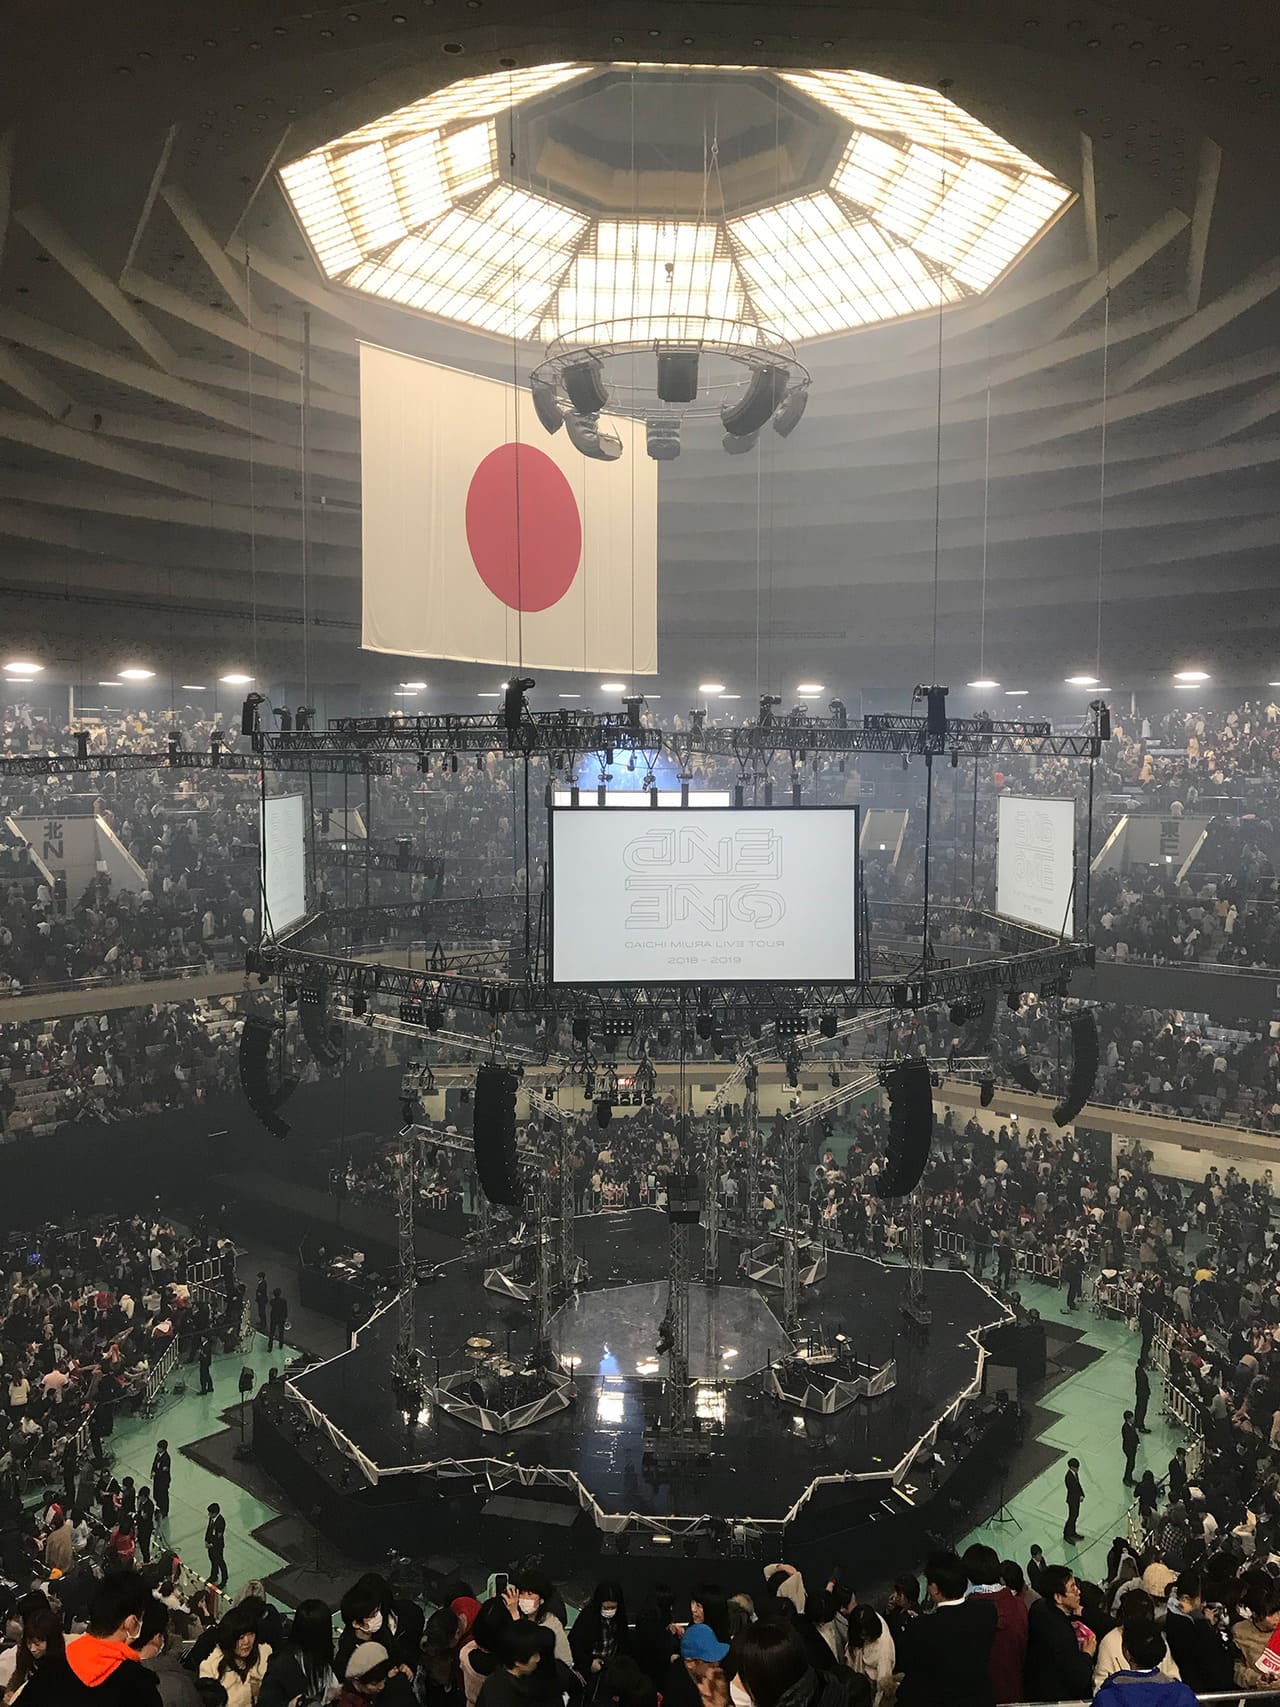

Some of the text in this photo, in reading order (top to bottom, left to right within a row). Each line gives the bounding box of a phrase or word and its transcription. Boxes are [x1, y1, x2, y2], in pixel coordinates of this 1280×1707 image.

[43, 821, 63, 840] 北
[43, 840, 64, 859] N
[670, 940, 713, 949] MIURA
[715, 940, 745, 949] LIVE
[749, 940, 785, 949] TOUR
[667, 956, 698, 965] 2018
[710, 956, 742, 965] 2019
